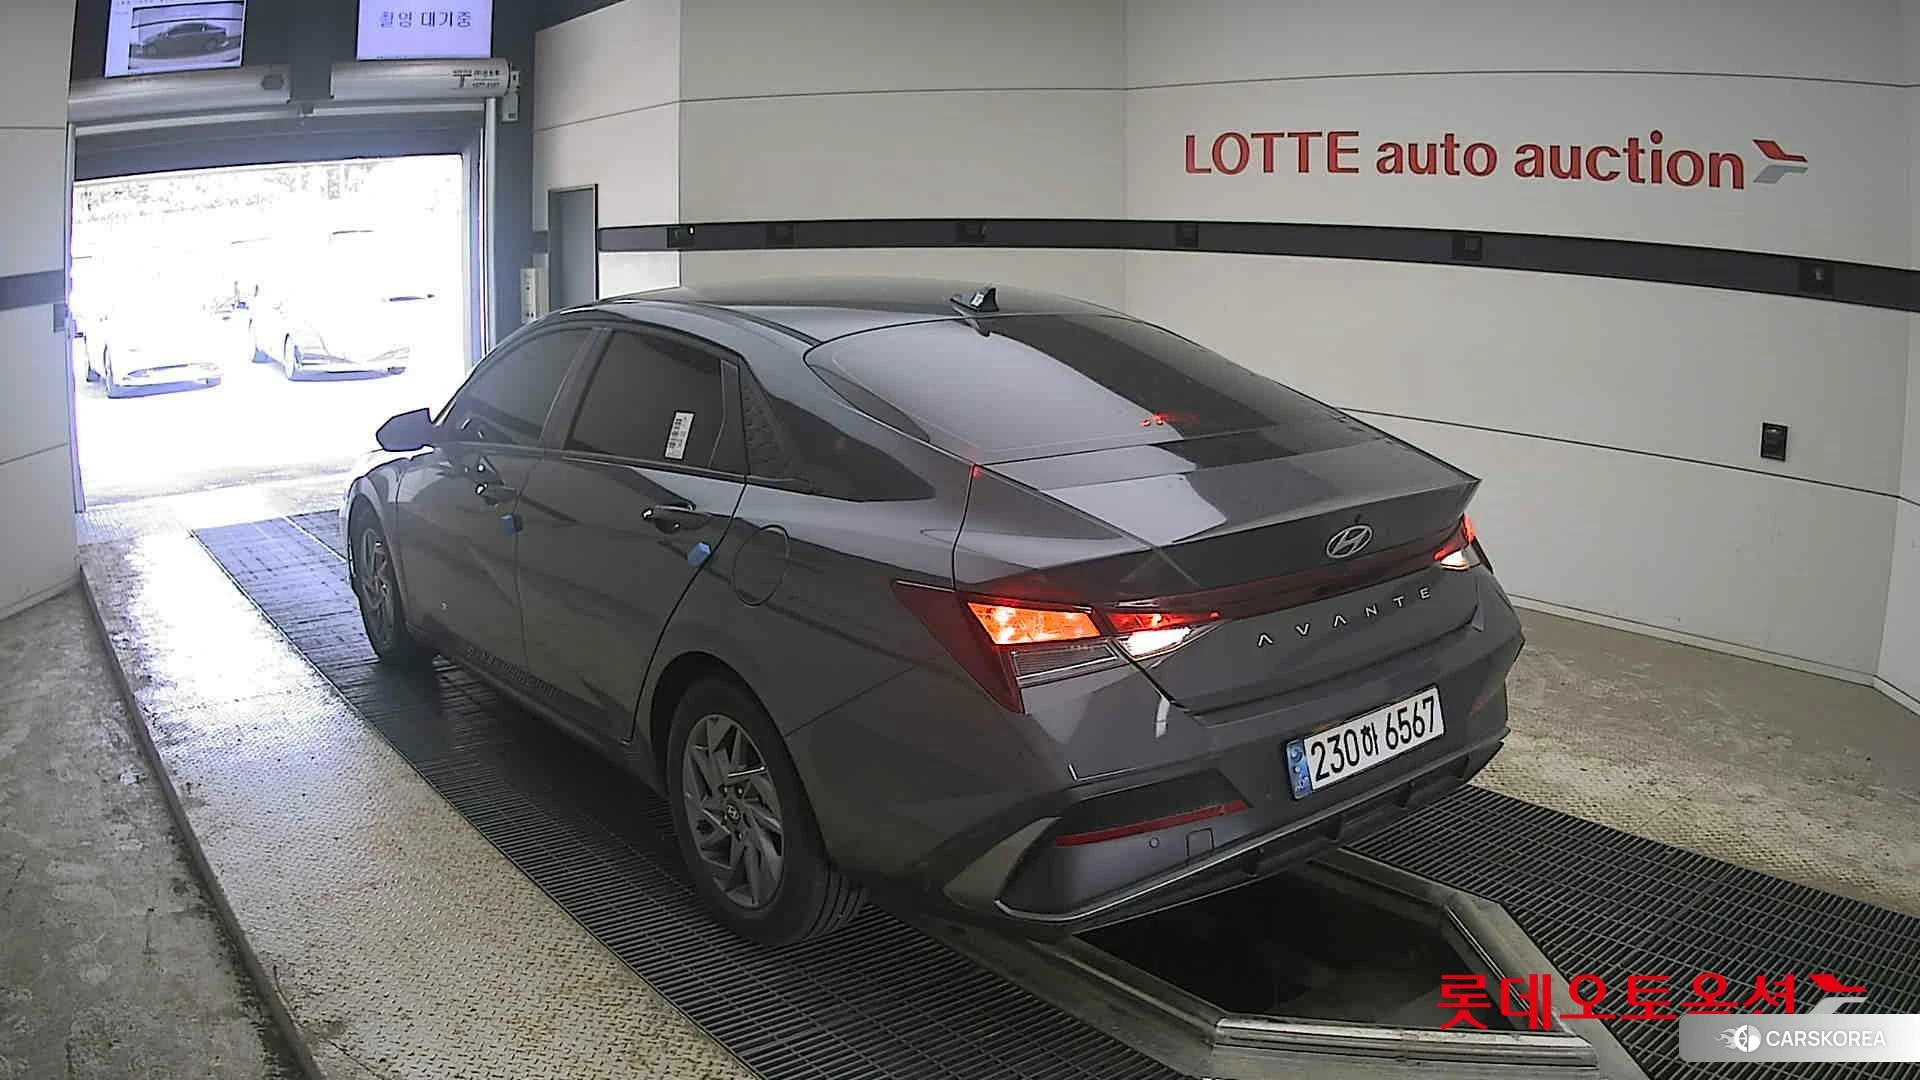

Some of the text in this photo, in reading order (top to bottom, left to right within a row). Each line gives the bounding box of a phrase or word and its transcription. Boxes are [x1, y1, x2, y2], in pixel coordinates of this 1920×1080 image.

[421, 11, 472, 28] 대기중
[1185, 130, 1745, 190] LOTTE auto auction
[1257, 587, 1432, 647] AVANTE
[1311, 696, 1435, 782] 230하 6567
